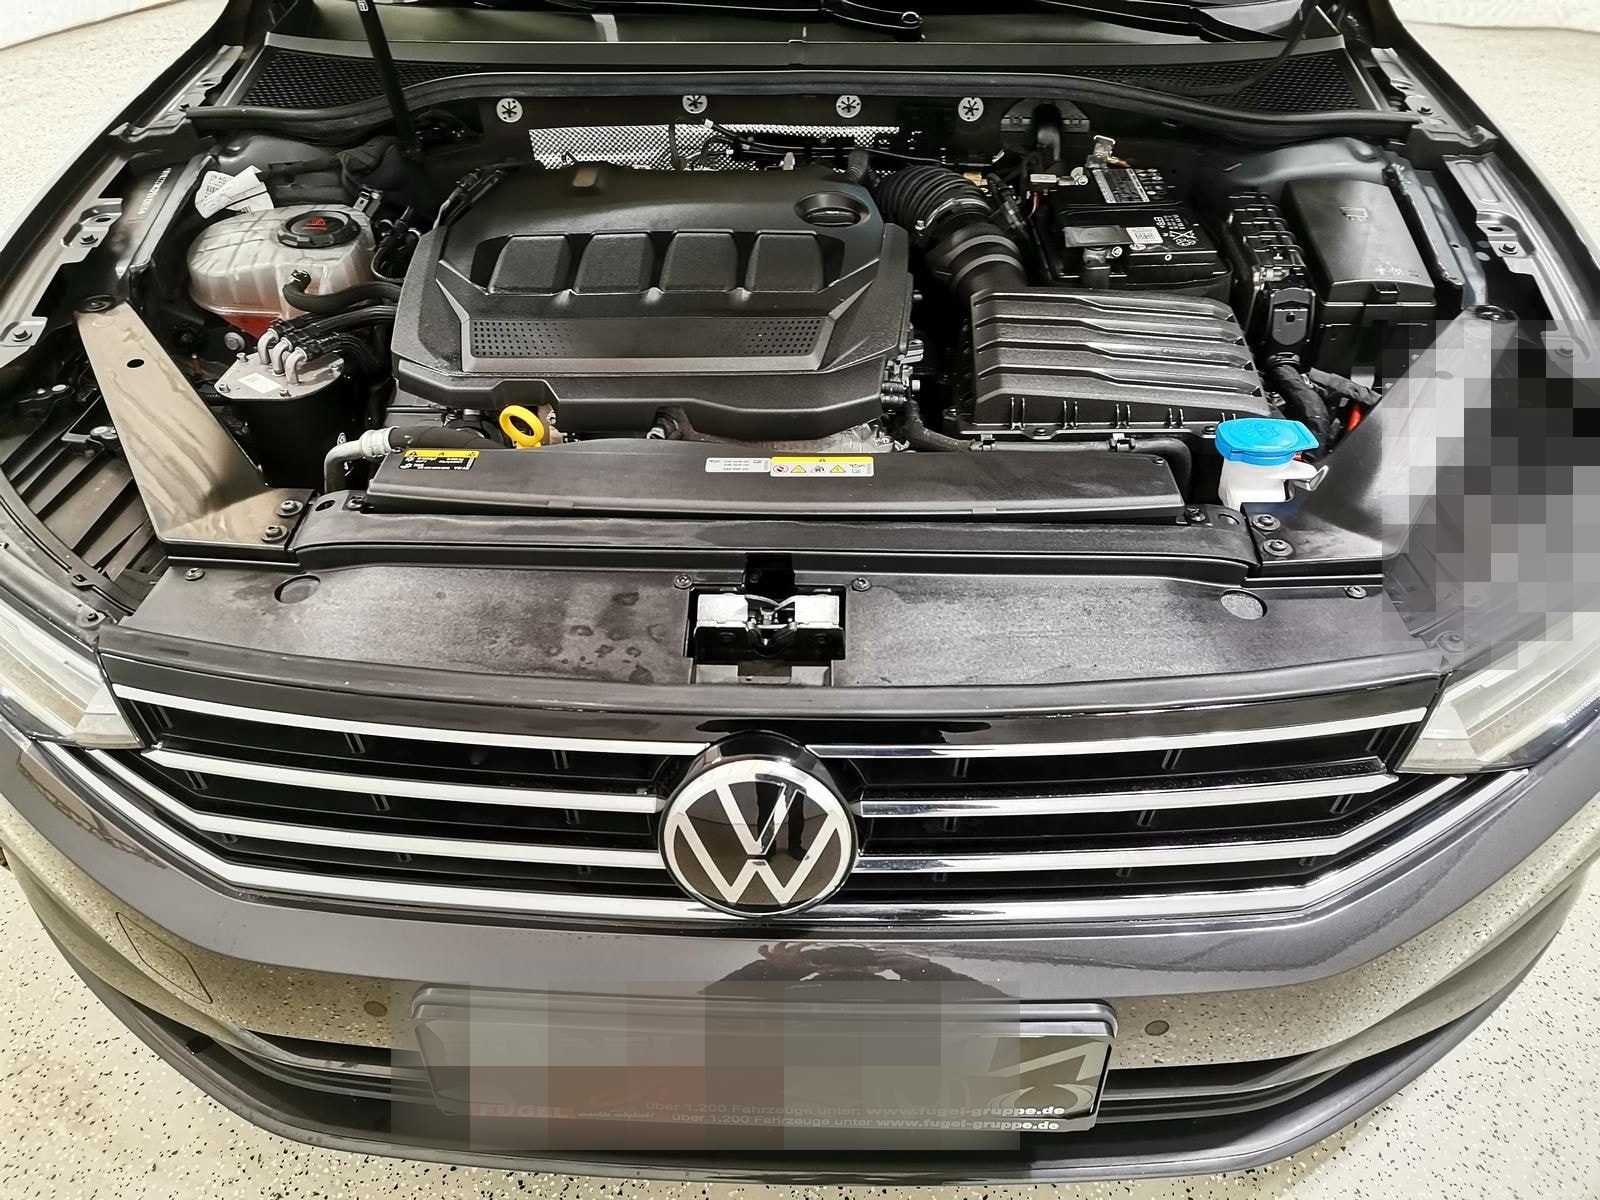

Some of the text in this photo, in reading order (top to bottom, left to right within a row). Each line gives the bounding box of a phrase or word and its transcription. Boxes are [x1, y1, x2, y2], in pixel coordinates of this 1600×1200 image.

[646, 1101, 681, 1112] über
[685, 1103, 728, 1113] 1.200
[731, 1104, 814, 1117] Fahrzeuge
[671, 1112, 705, 1122] über
[709, 1114, 750, 1124] 1.200
[754, 1116, 830, 1127] Fahrzeuge
[876, 1119, 1060, 1130] www.fugel-gruppe.de
